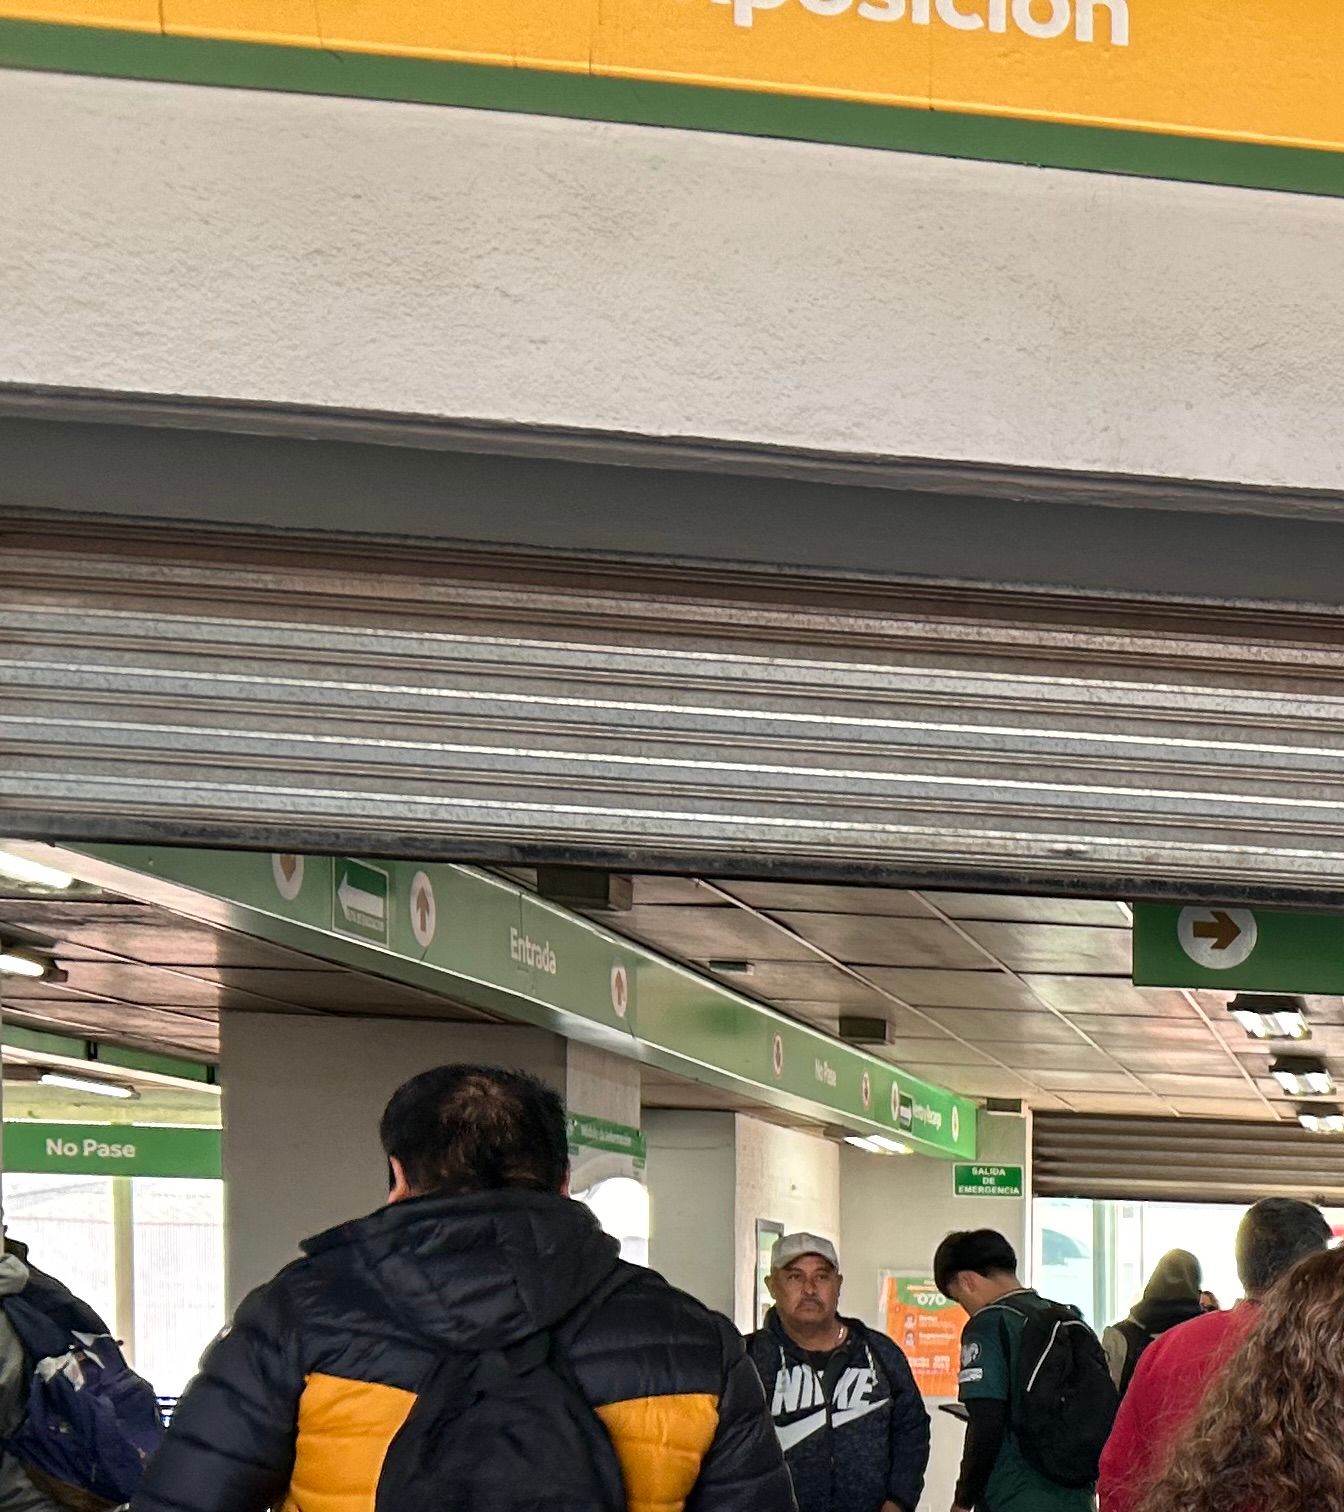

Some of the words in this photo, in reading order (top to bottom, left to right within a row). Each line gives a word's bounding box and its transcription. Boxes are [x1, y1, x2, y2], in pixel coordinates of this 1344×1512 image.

[510, 925, 556, 975] Entrada
[45, 1138, 78, 1157] No
[82, 1138, 136, 1158] Pase
[971, 1166, 1006, 1177] SALIDA
[982, 1176, 996, 1186] DE
[958, 1185, 1020, 1195] EMERGENCIA
[916, 1292, 947, 1307] 070
[770, 1363, 873, 1416] NIKE
